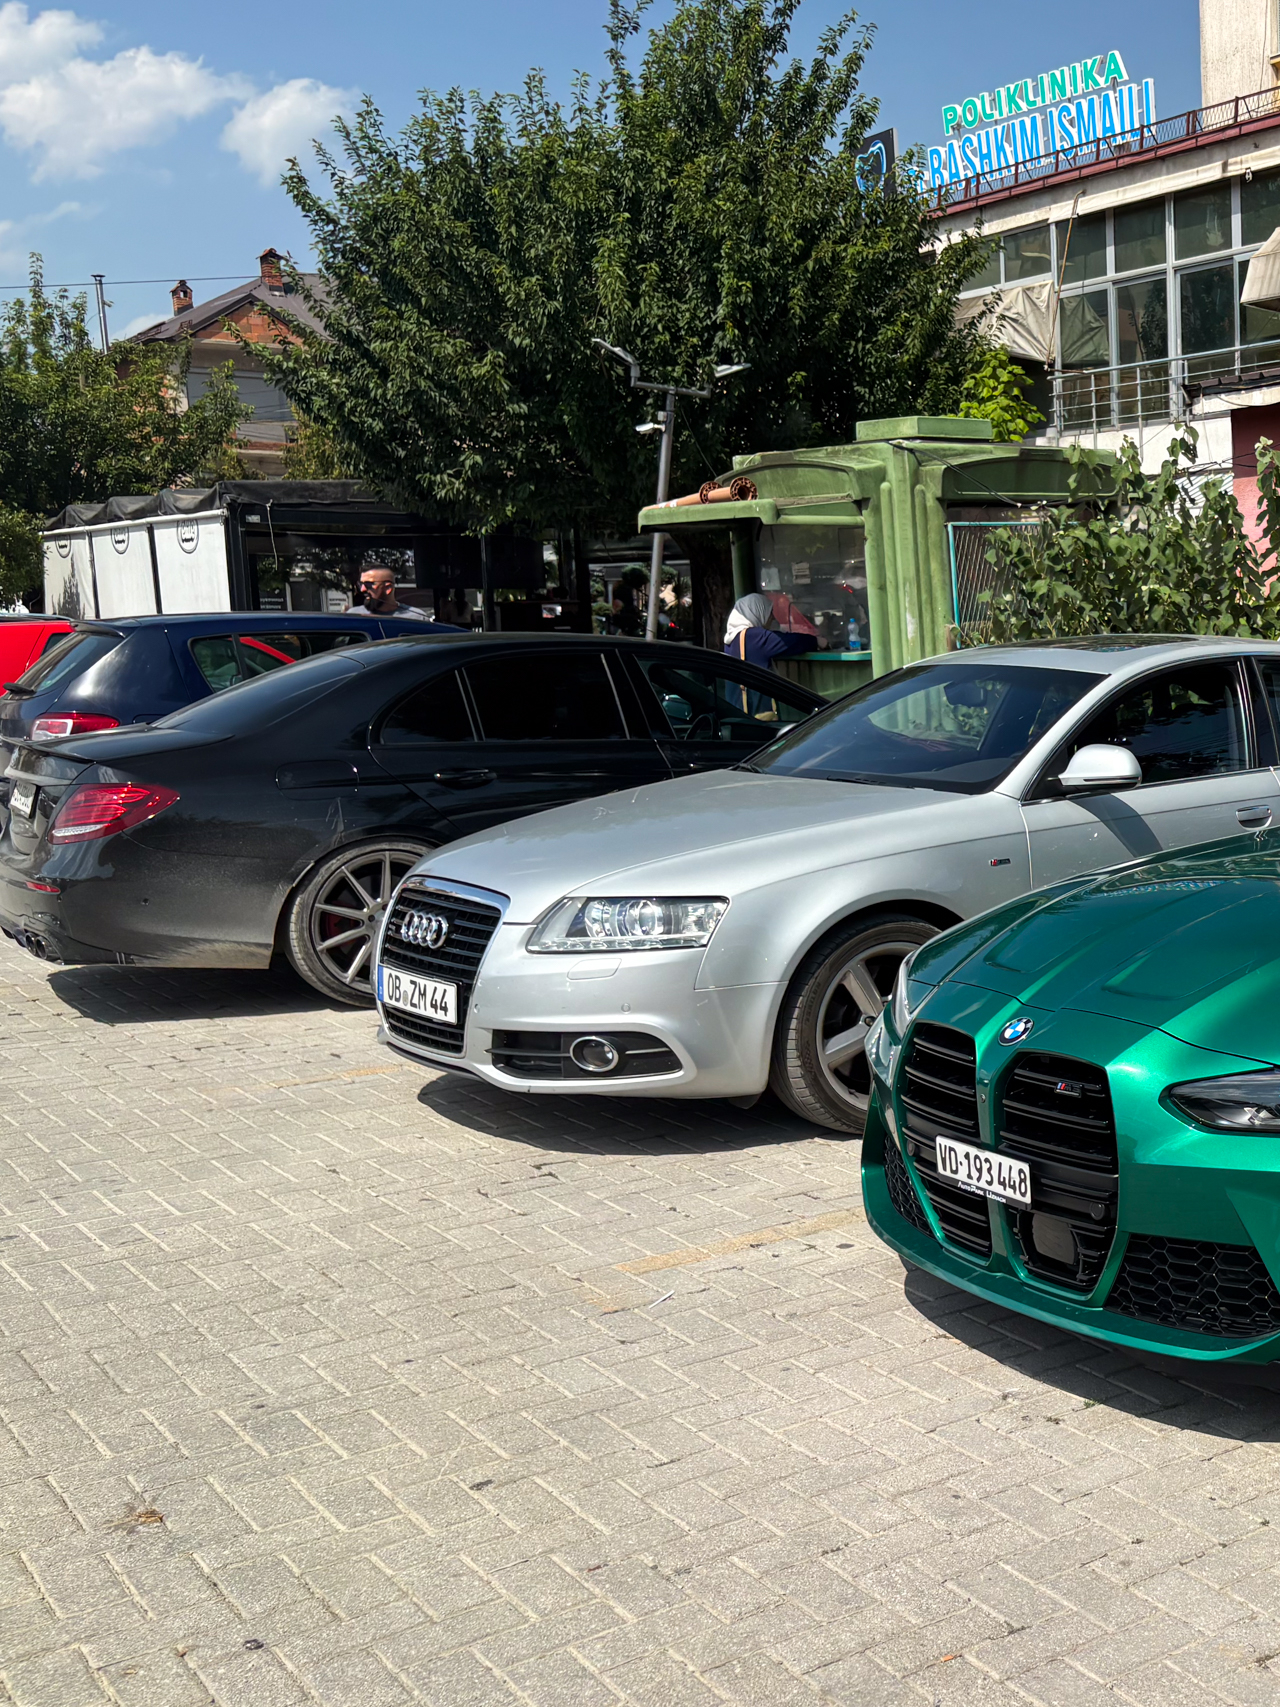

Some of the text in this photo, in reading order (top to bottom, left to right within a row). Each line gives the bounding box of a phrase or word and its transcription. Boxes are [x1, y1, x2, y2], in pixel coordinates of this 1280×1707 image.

[942, 50, 1129, 136] POLIKLINIKA
[928, 113, 1044, 197] BASHKIM
[1047, 78, 1157, 163] ISMAILI
[387, 972, 449, 1017] OB ZM 44
